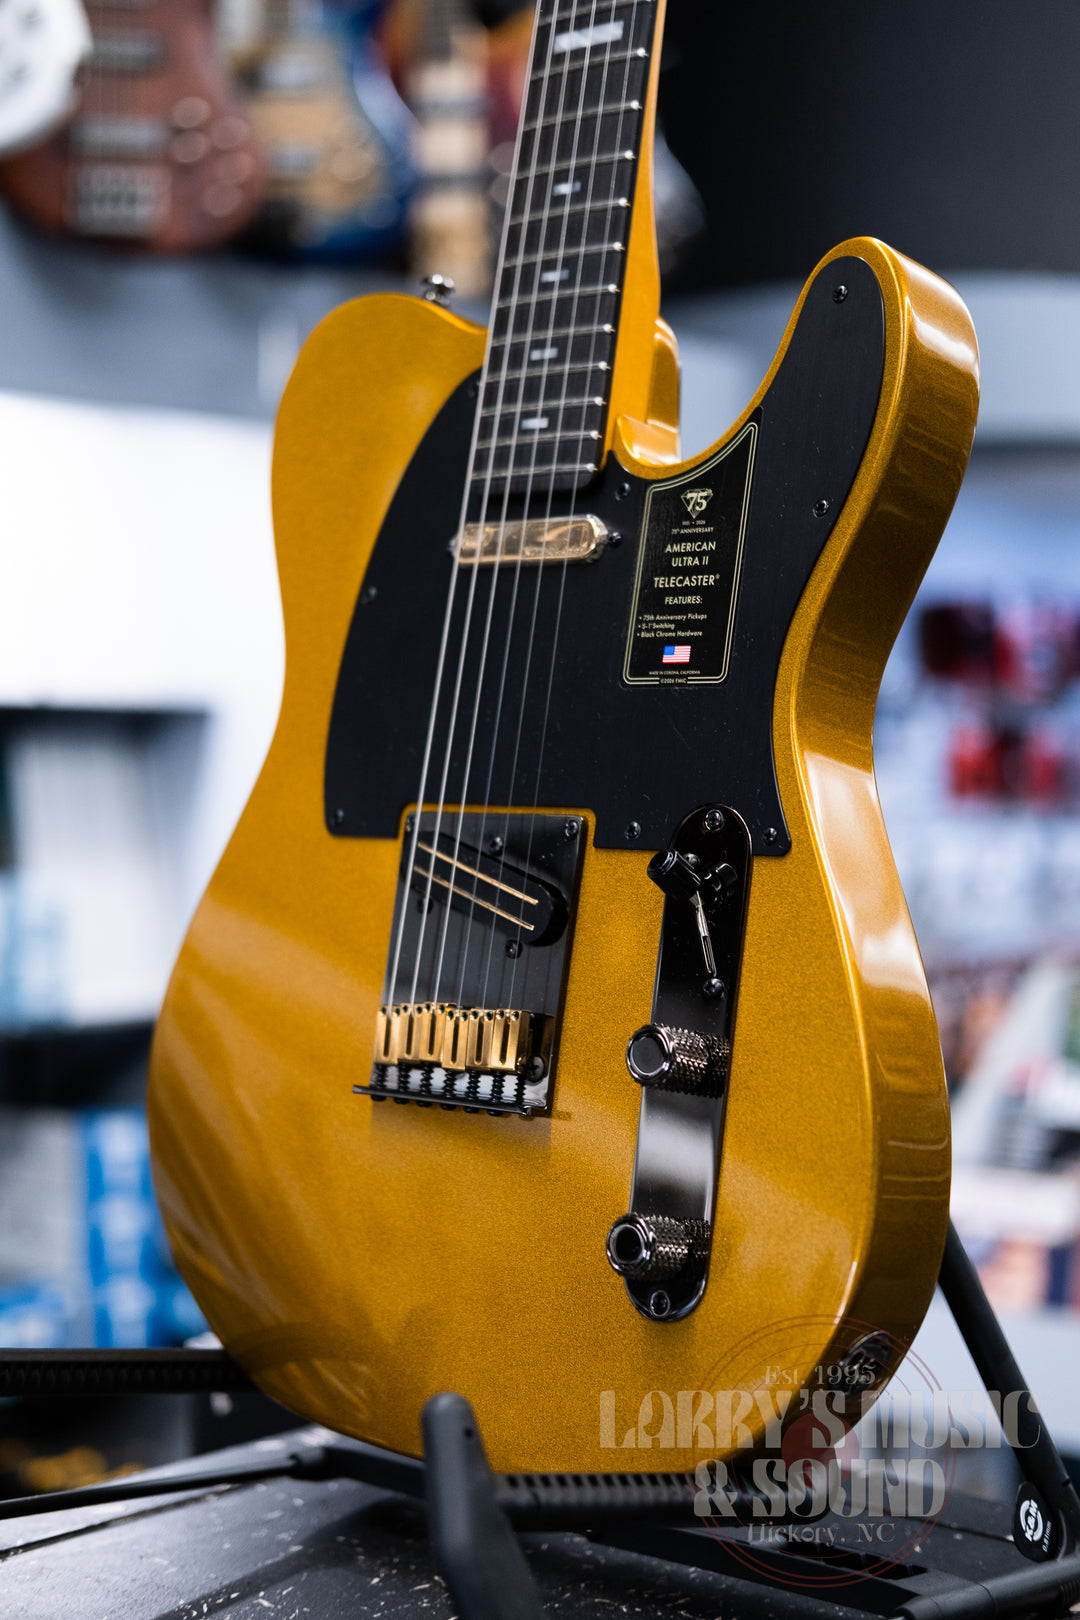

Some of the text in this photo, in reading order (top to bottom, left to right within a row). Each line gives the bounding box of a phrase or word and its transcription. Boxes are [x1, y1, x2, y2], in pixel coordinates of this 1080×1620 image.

[686, 491, 708, 511] 75
[665, 541, 716, 553] AMERICAN
[671, 556, 709, 567] ULTRA II
[664, 595, 703, 605] FEATURES:
[652, 622, 675, 630] Switching
